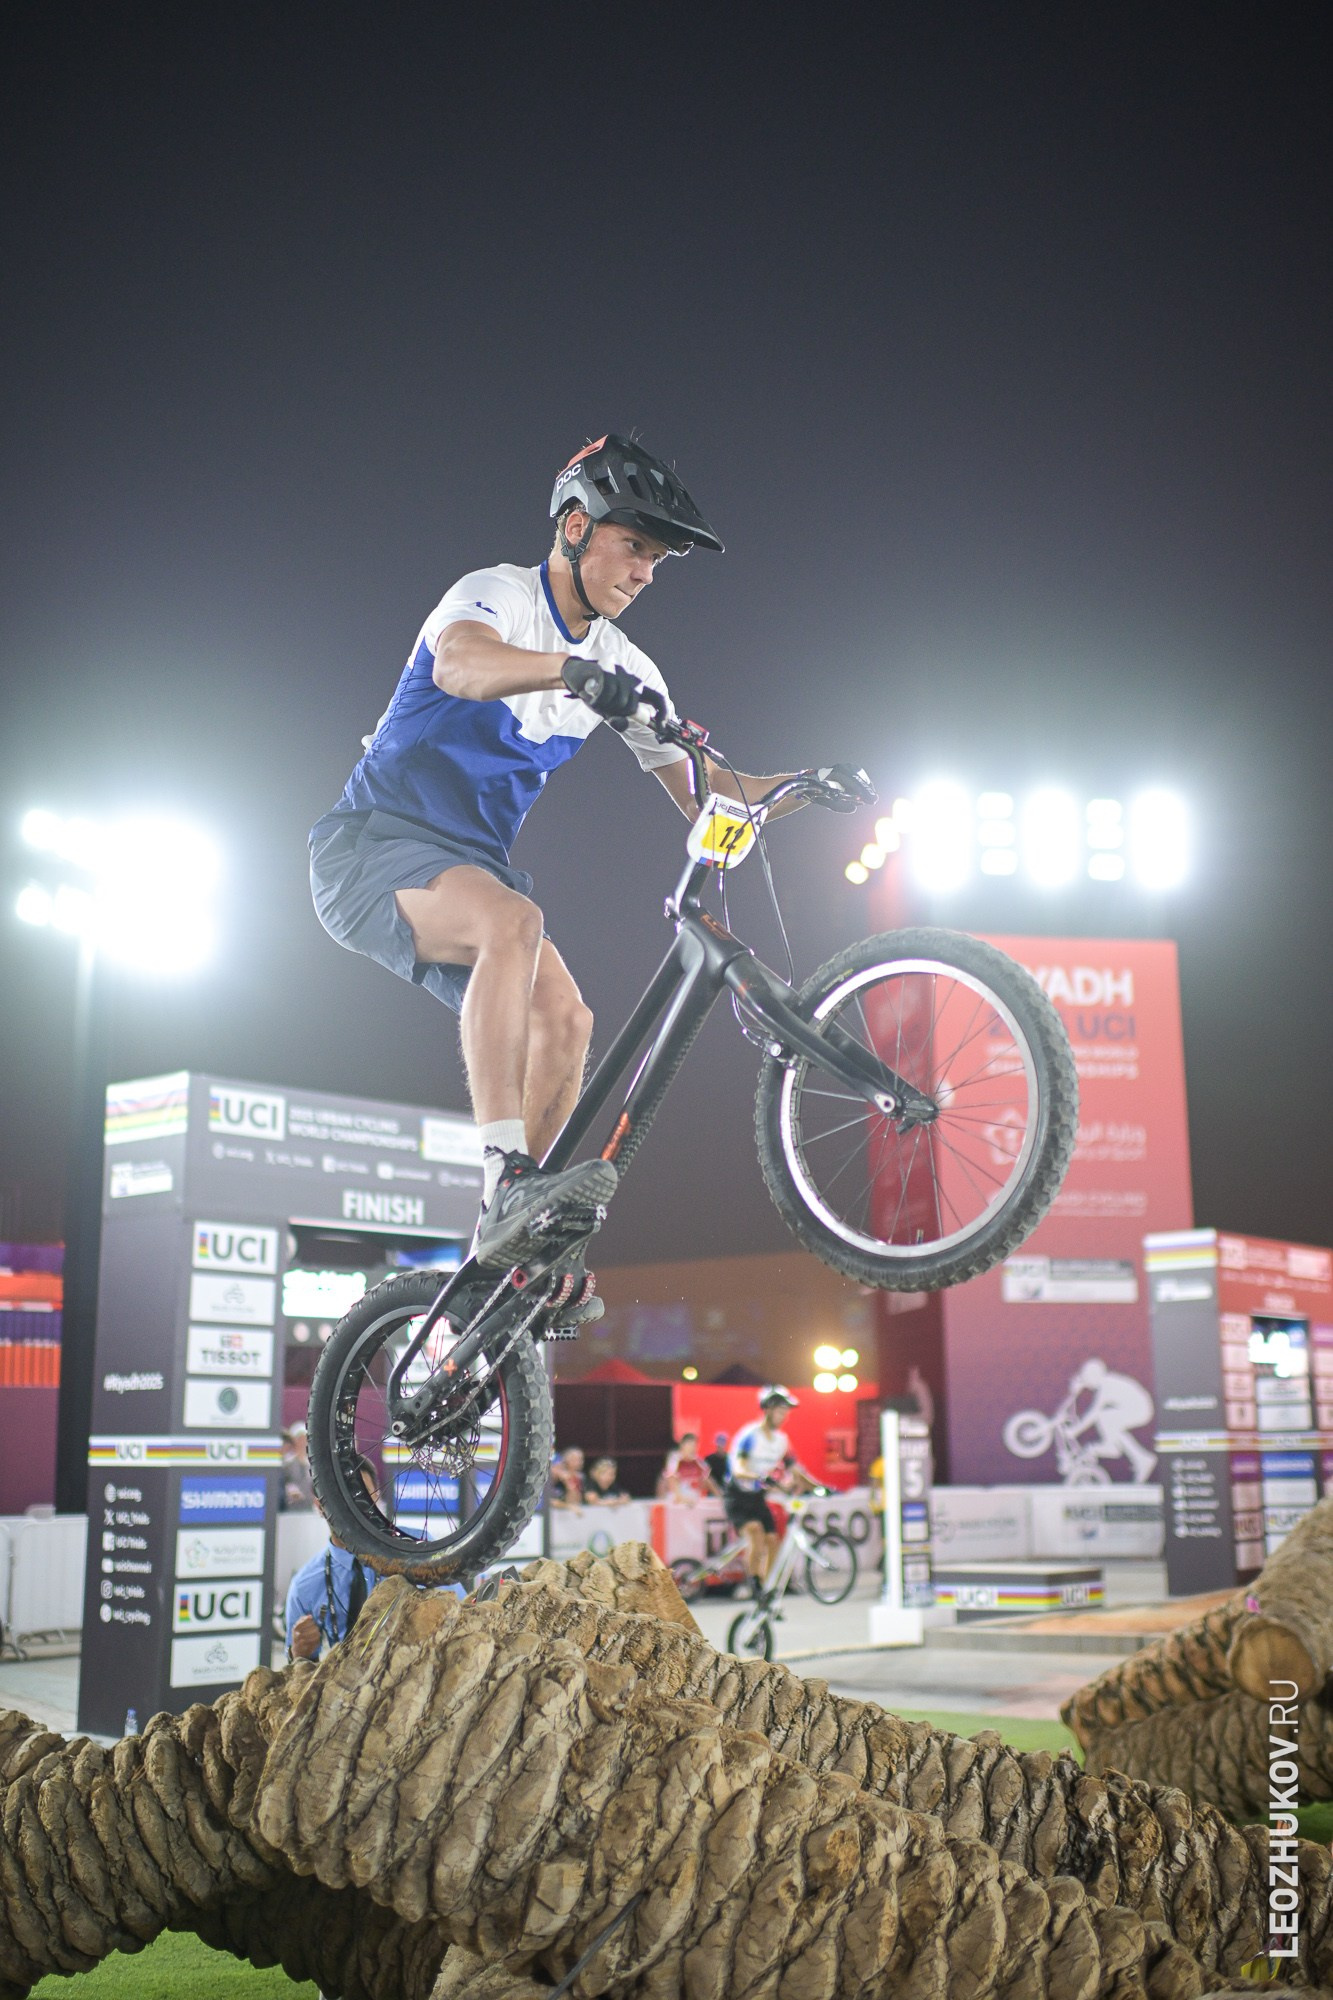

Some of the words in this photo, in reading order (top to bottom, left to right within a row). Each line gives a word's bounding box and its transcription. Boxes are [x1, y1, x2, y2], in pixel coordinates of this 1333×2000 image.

[719, 826, 744, 850] 12
[1025, 967, 1134, 1007] YADH
[1077, 1013, 1136, 1041] UCI
[223, 1090, 278, 1131] UCI
[342, 1189, 425, 1225] FINISH
[212, 1233, 267, 1265] UCI
[200, 1349, 261, 1366] TISSOT
[116, 1444, 144, 1461] UCI
[208, 1444, 244, 1461] UCI
[906, 1461, 924, 1499] 5
[181, 1491, 265, 1510] SHIMANO
[193, 1591, 250, 1621] UCI
